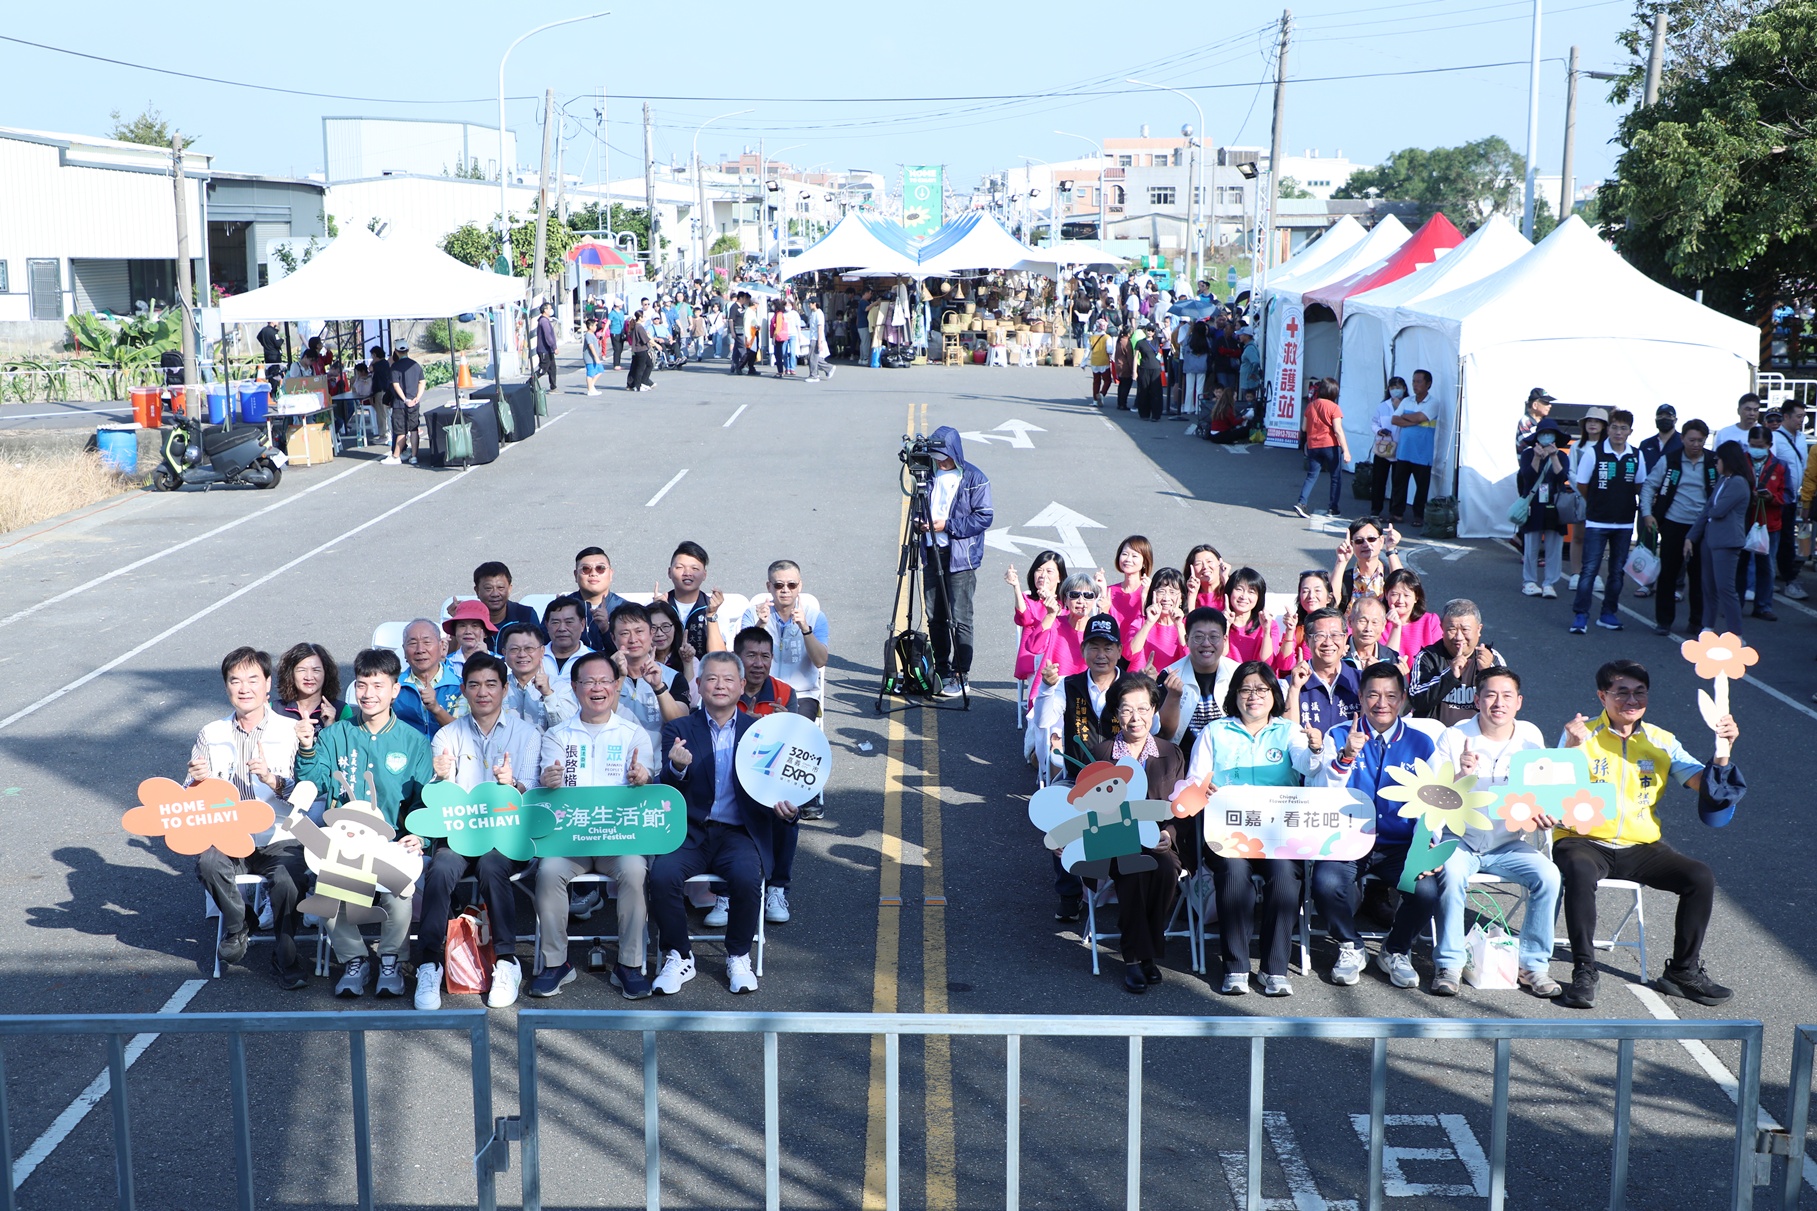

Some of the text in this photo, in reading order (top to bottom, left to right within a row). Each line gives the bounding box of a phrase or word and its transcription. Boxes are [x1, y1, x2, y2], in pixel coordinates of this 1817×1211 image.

[909, 169, 937, 178] HOME
[1276, 342, 1298, 419] 救護站
[781, 764, 816, 786] EXPO
[159, 800, 206, 815] HOME
[442, 803, 488, 817] HOME
[161, 811, 238, 829] TO CHIAYI
[444, 815, 521, 831] TO CHIAYI
[554, 806, 665, 830] 海生活節
[588, 826, 617, 834] Chiayi
